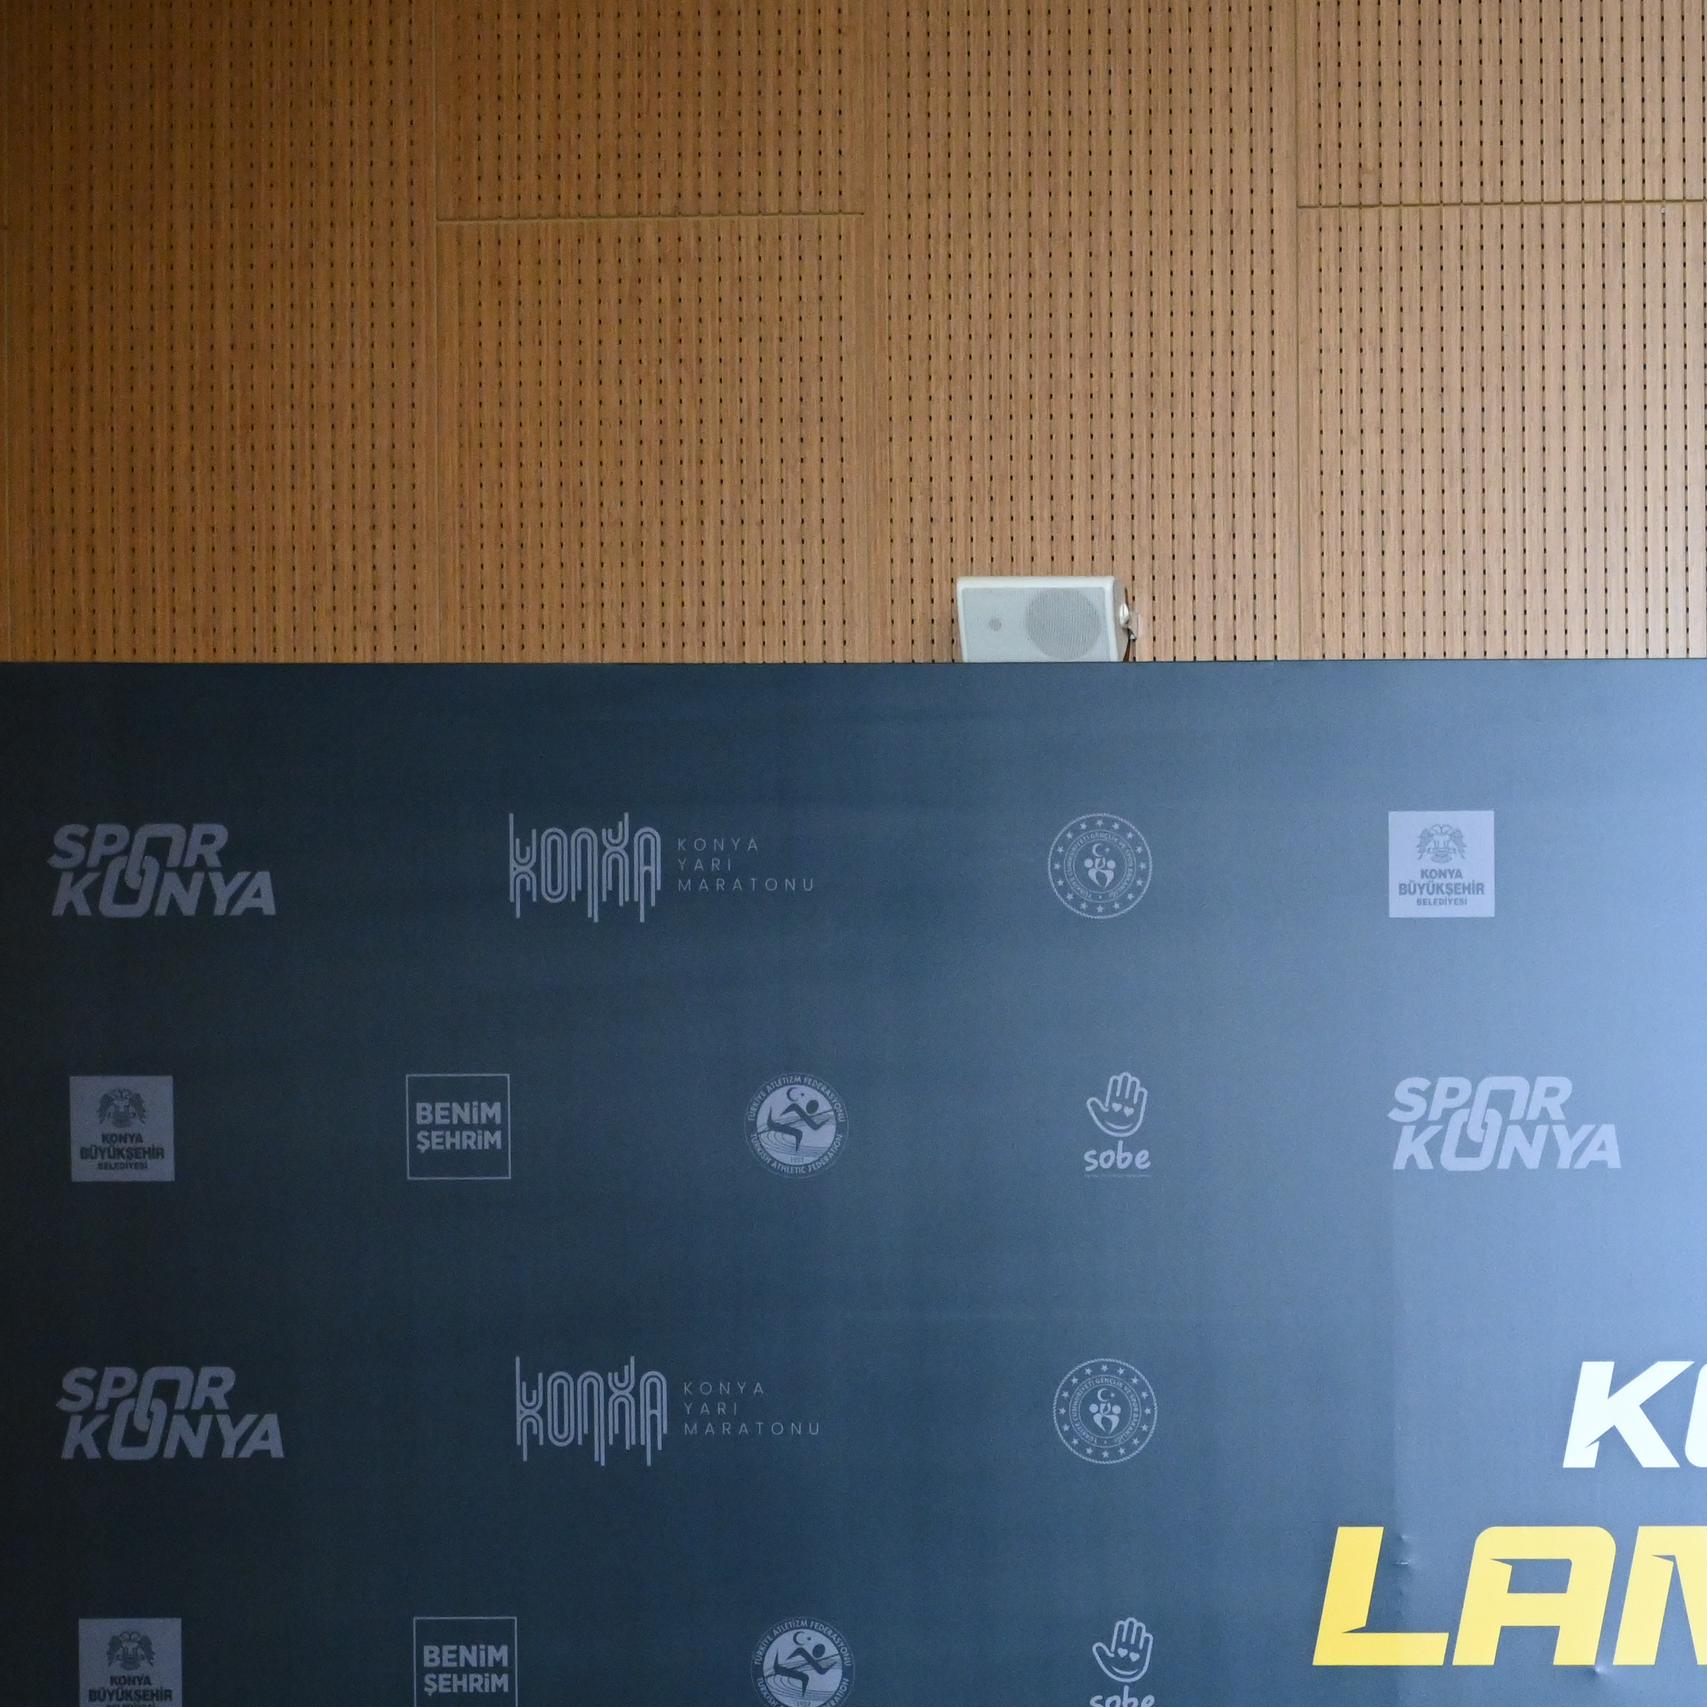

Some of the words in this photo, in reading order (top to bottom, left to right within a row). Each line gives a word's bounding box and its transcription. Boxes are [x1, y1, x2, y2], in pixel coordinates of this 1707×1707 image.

[48, 823, 227, 871] SPOR
[677, 838, 758, 852] KONYA
[677, 858, 732, 872] YARI
[1421, 868, 1463, 879] KONYA
[53, 863, 277, 917] KONYA
[677, 878, 814, 892] MARATONU
[1388, 1076, 1571, 1125] SPOR
[101, 1133, 144, 1144] KONYA
[1393, 1116, 1622, 1171] KONYA
[1083, 1140, 1152, 1172] sobe
[56, 1366, 235, 1414] SPOR
[683, 1382, 764, 1396] KONYA
[683, 1402, 738, 1416] YARI
[61, 1406, 285, 1460] KONYA
[683, 1422, 820, 1436] MARATONU
